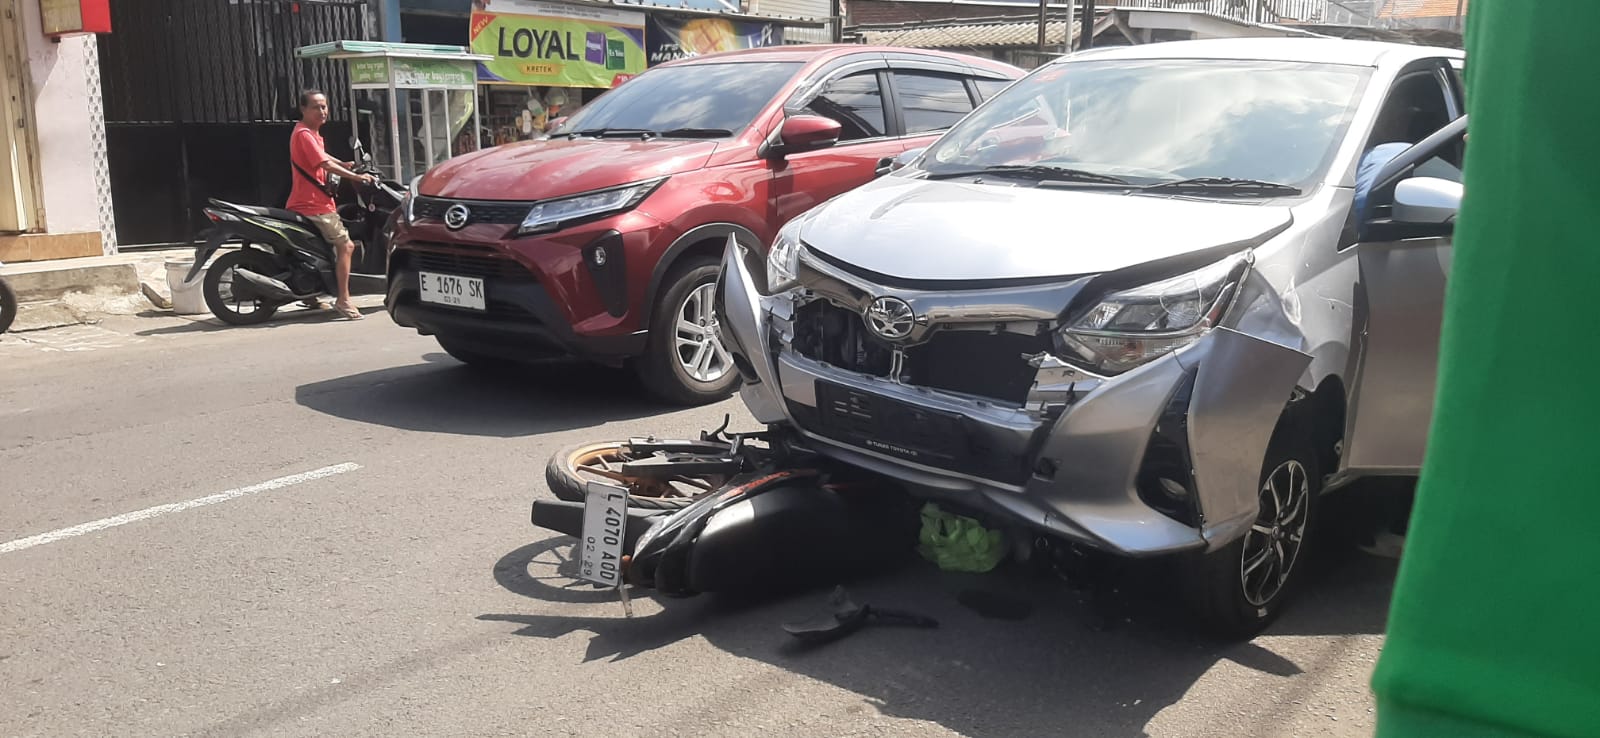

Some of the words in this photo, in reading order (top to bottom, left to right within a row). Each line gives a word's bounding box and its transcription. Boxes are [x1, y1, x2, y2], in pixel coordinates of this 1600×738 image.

[473, 16, 489, 34] NEW
[498, 26, 580, 61] LOYAL
[526, 65, 552, 73] KRETEK
[421, 274, 428, 291] E
[437, 276, 463, 295] 1676
[469, 280, 482, 298] SK
[607, 493, 623, 502] L
[603, 507, 622, 546] 4070
